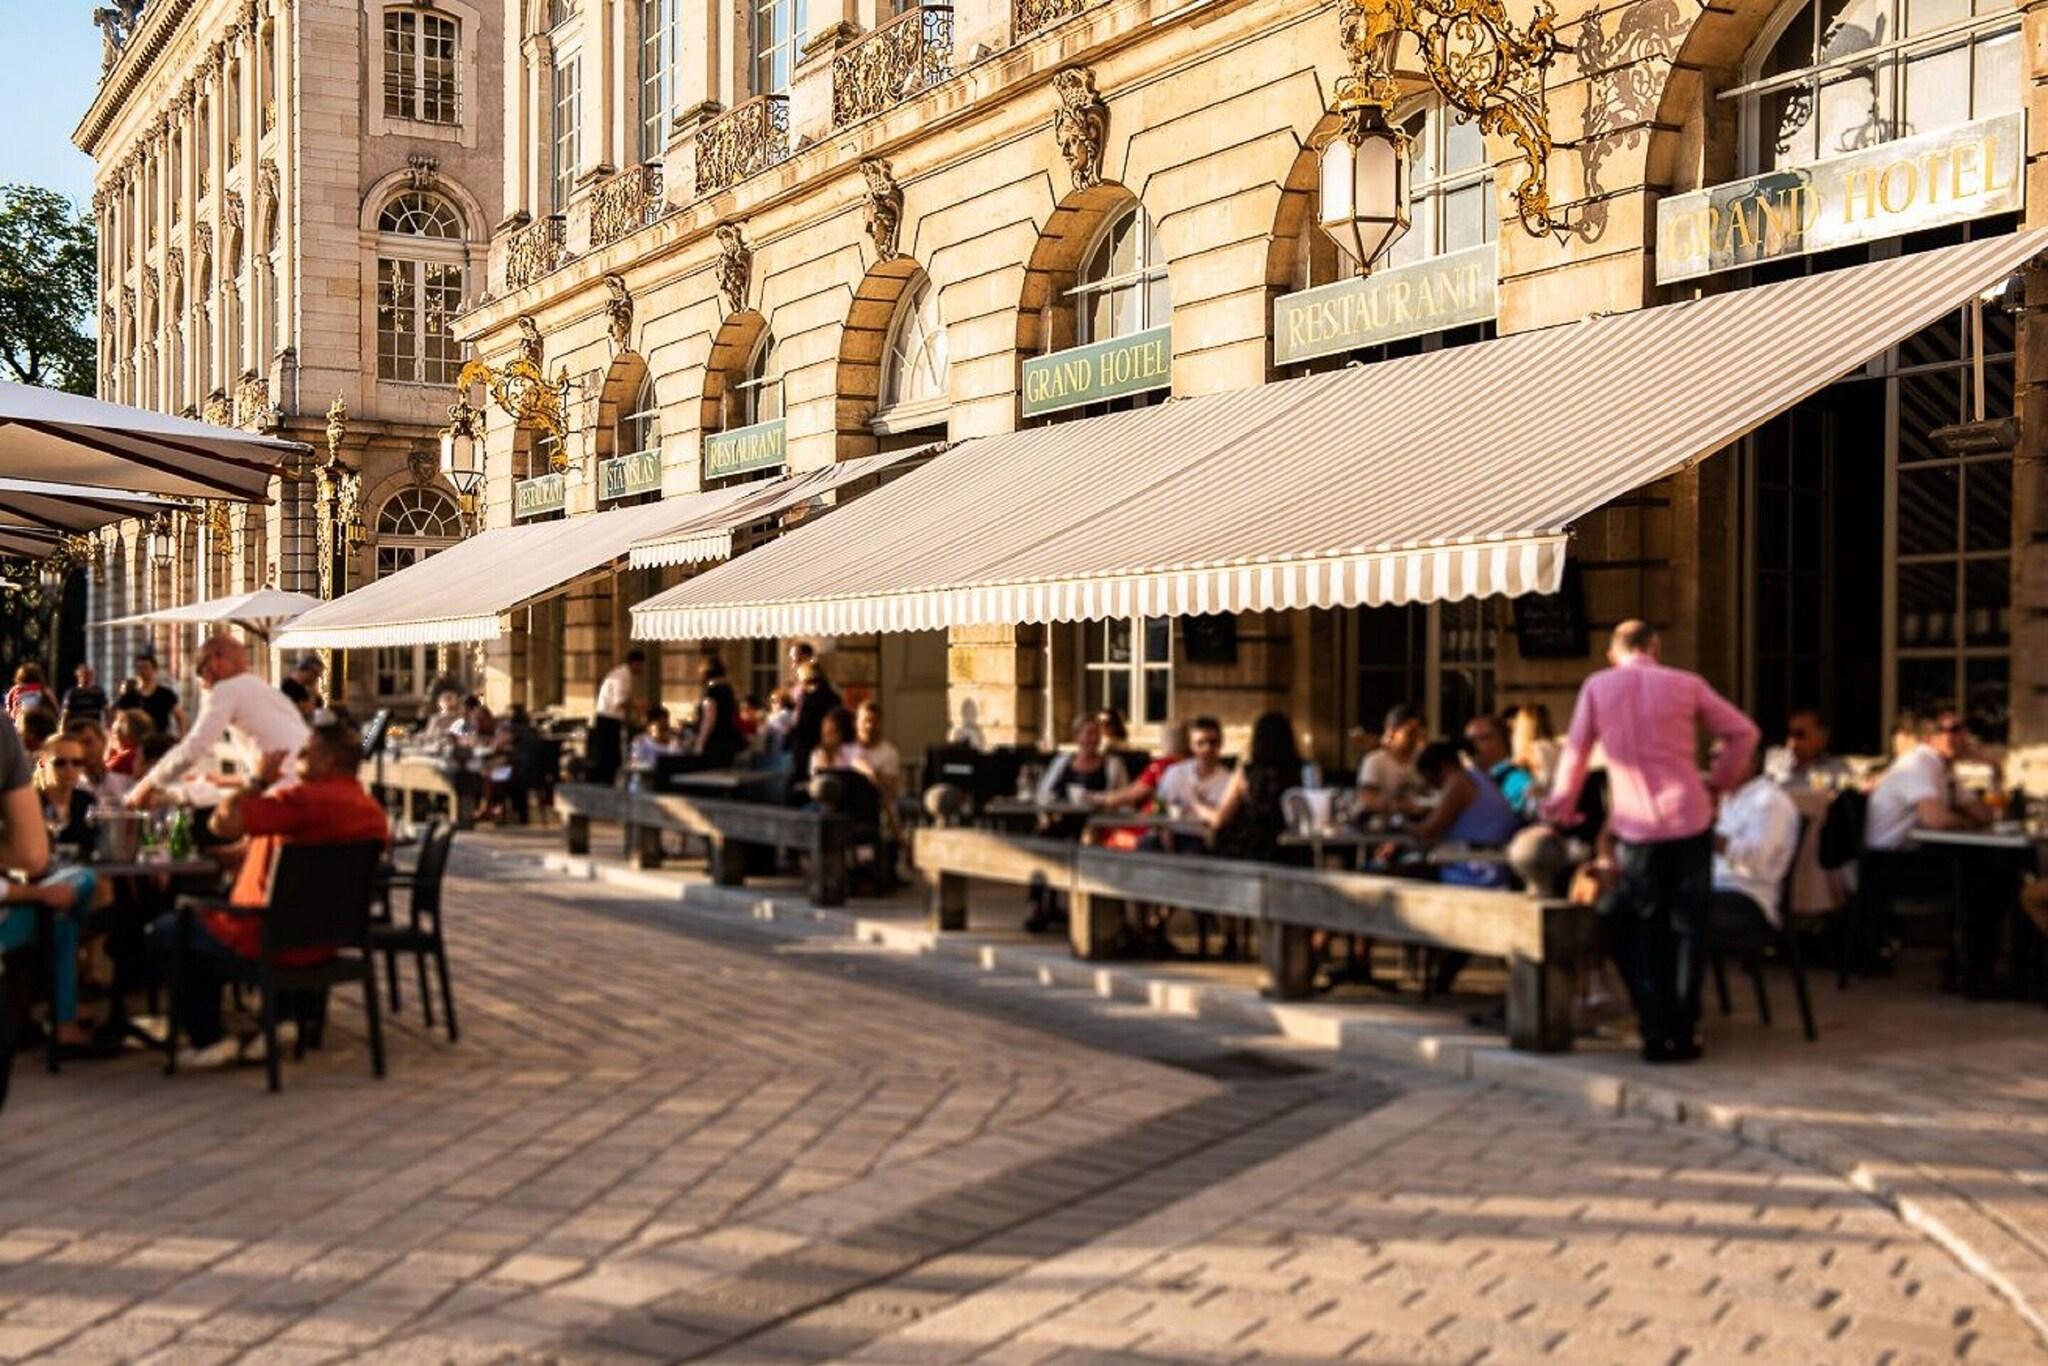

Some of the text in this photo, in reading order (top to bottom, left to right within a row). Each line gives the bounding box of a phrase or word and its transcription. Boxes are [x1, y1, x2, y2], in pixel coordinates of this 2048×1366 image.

[1667, 136, 2012, 262] GRAND HOTEL
[1288, 262, 1482, 348] RESTAURANT
[1027, 339, 1169, 403] GRAND HOTEL
[710, 427, 783, 470] RESTAURANT
